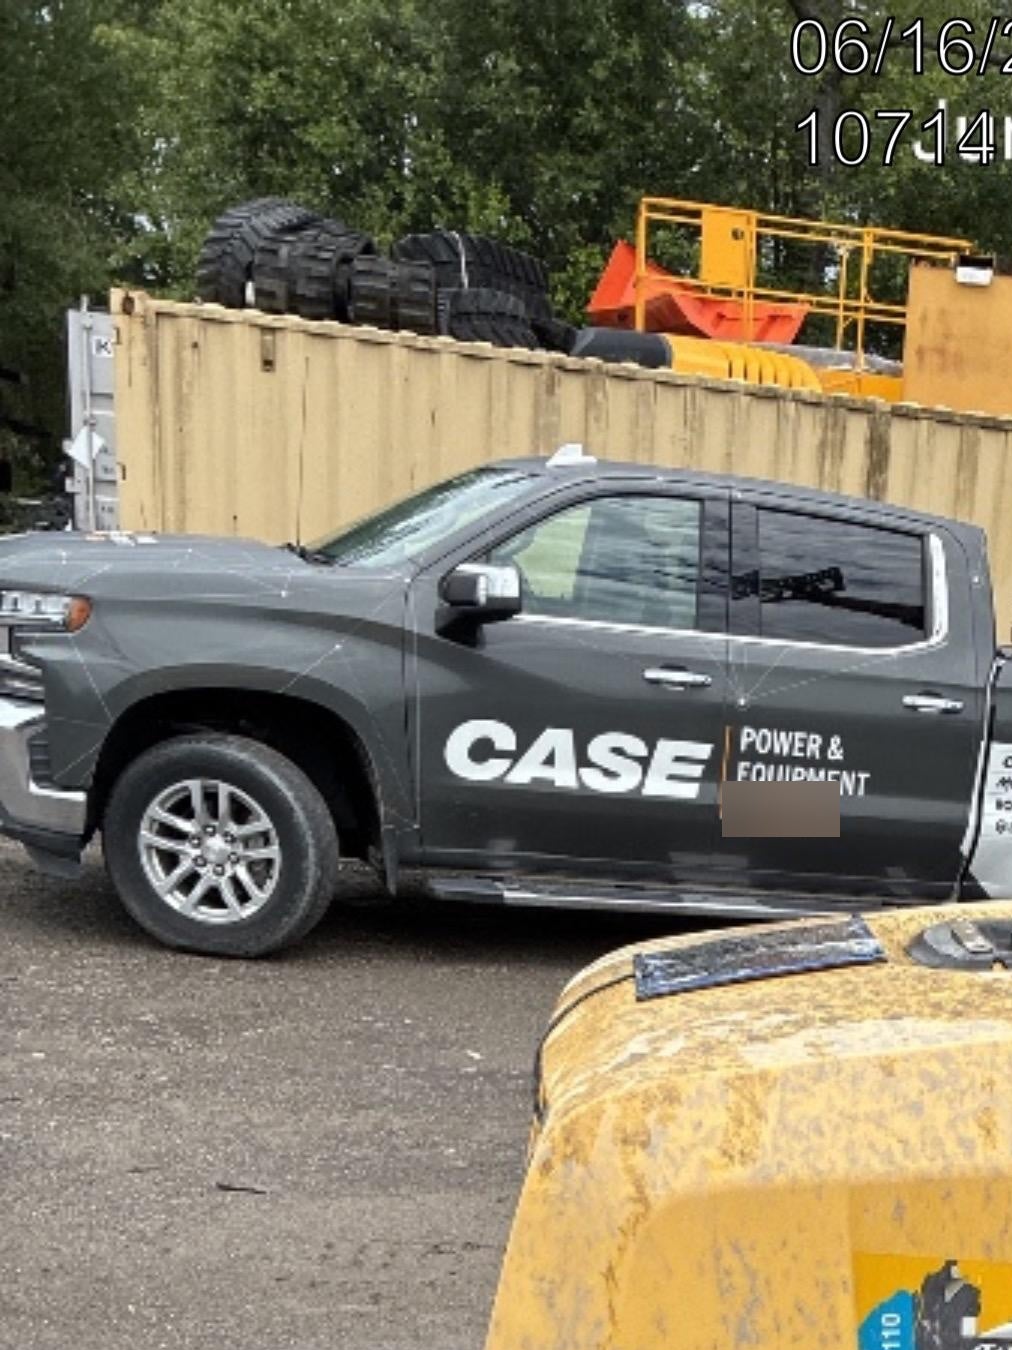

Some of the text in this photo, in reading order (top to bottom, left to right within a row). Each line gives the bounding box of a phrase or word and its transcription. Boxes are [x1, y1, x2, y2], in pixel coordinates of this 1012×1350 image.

[444, 719, 714, 799] CASE
[740, 725, 844, 760] POWER &
[881, 1312, 902, 1350] 110
